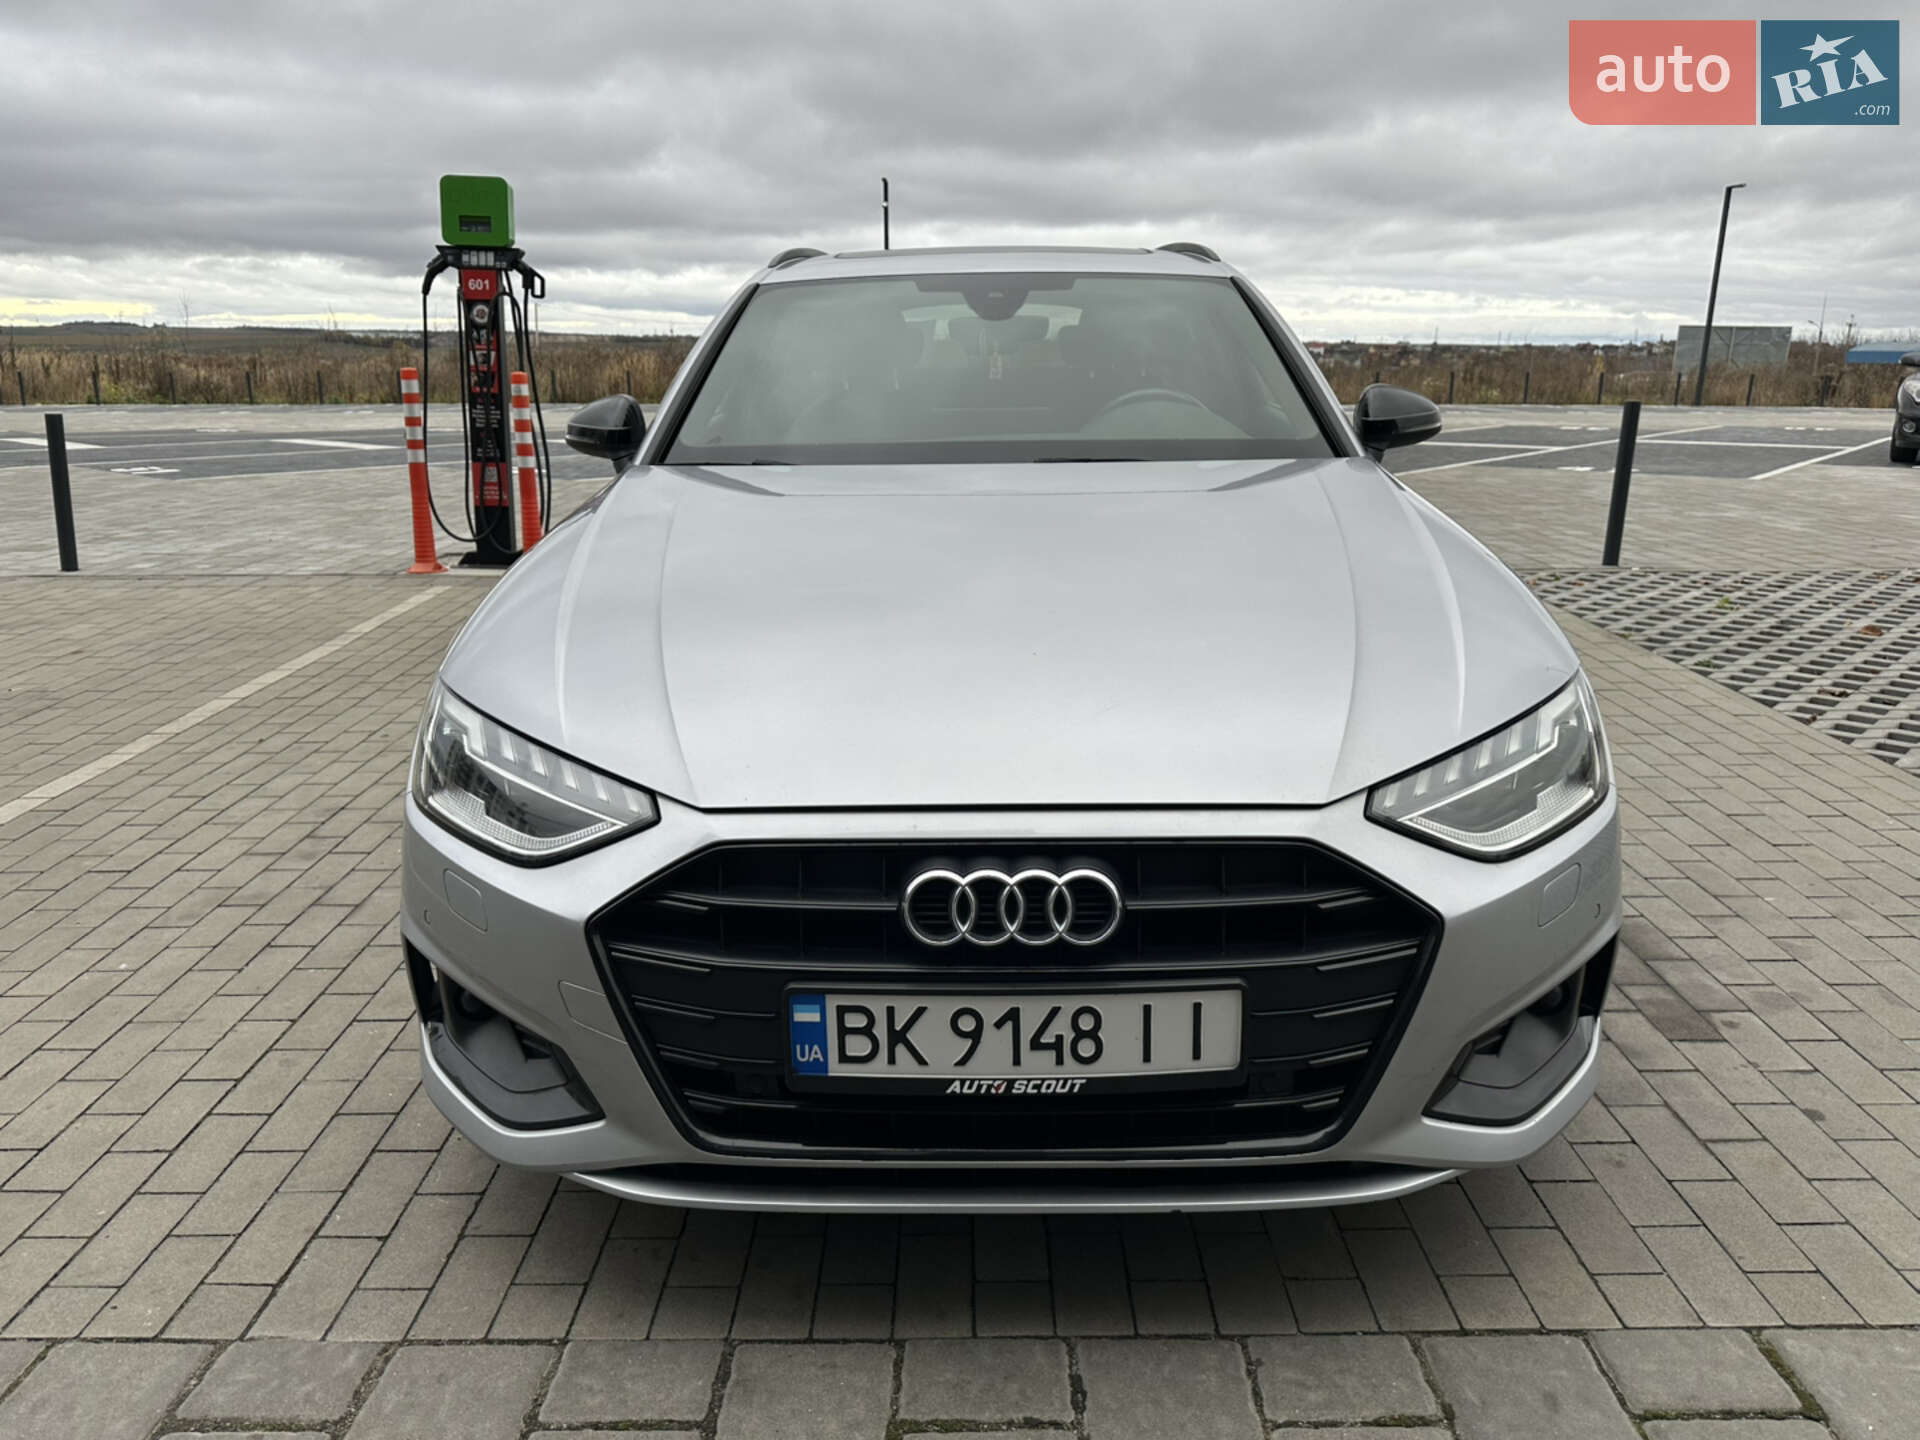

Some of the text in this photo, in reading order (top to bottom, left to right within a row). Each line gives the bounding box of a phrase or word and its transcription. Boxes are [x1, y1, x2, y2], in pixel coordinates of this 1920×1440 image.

[468, 279, 490, 290] 601
[836, 1005, 929, 1066] BK
[950, 1006, 1104, 1067] 9148
[796, 1044, 824, 1062] UA
[1012, 1079, 1087, 1094] SCOUT
